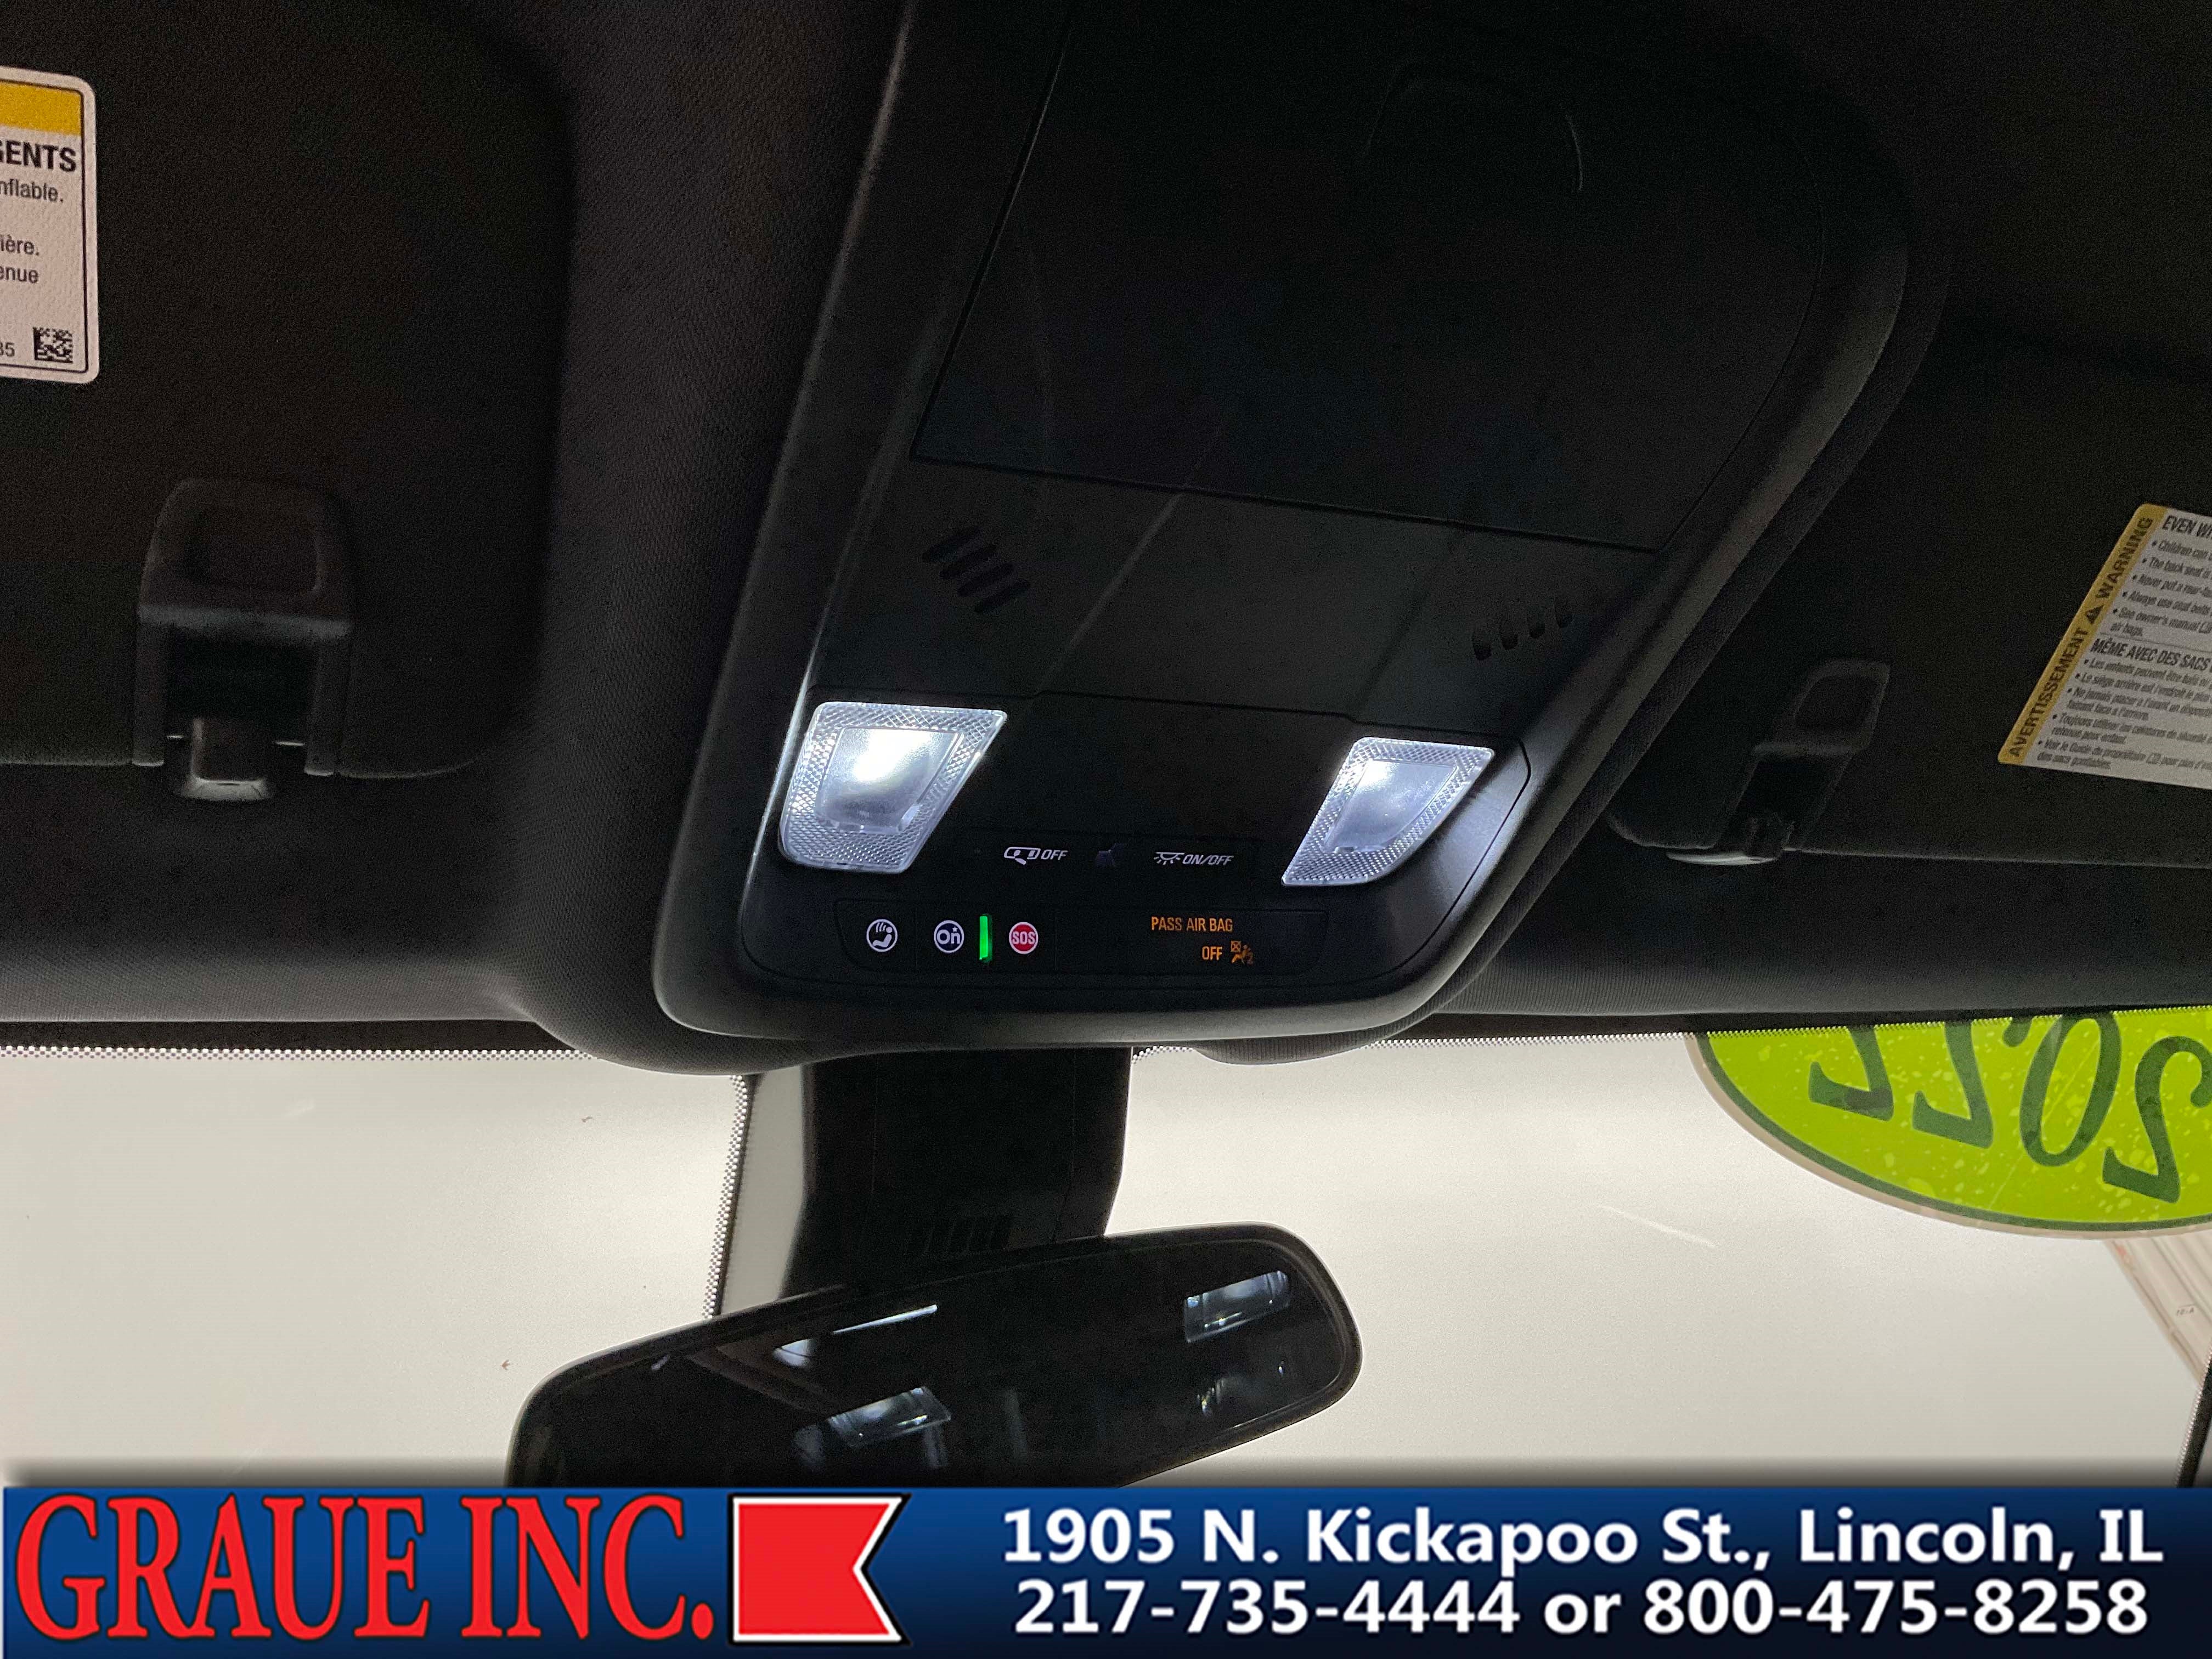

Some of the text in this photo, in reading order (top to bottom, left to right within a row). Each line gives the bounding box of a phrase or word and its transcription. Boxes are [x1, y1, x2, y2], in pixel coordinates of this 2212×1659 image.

[0, 140, 76, 172] ENTS
[2162, 515, 2197, 535] EVEN
[2008, 627, 2087, 758] AVERTISSEMENT
[2095, 517, 2153, 599] WARNING
[2090, 637, 2210, 671] MÊME AVEC DES SACS
[1041, 849, 1068, 861] OFF
[1182, 854, 1235, 866] ON/OFF
[1151, 916, 1233, 932] PASS AIR BAG
[936, 929, 960, 945] On
[1012, 931, 1036, 945] SOS
[1201, 945, 1223, 961] OFF
